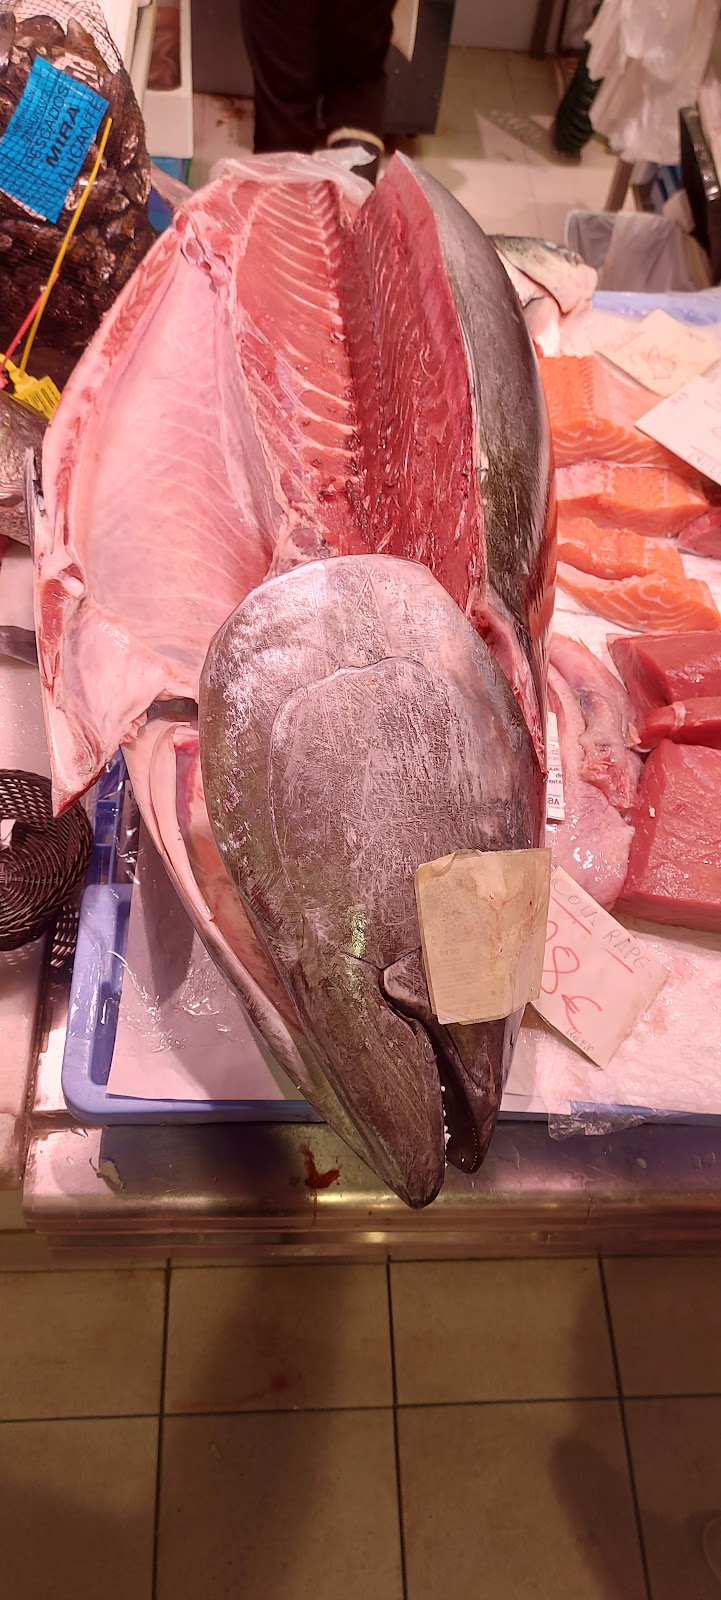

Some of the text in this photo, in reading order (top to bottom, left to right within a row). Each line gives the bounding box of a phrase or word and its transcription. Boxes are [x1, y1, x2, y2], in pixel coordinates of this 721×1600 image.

[26, 86, 69, 168] PESCADOS
[46, 106, 80, 168] MIRA
[58, 96, 101, 185] ALICANTE
